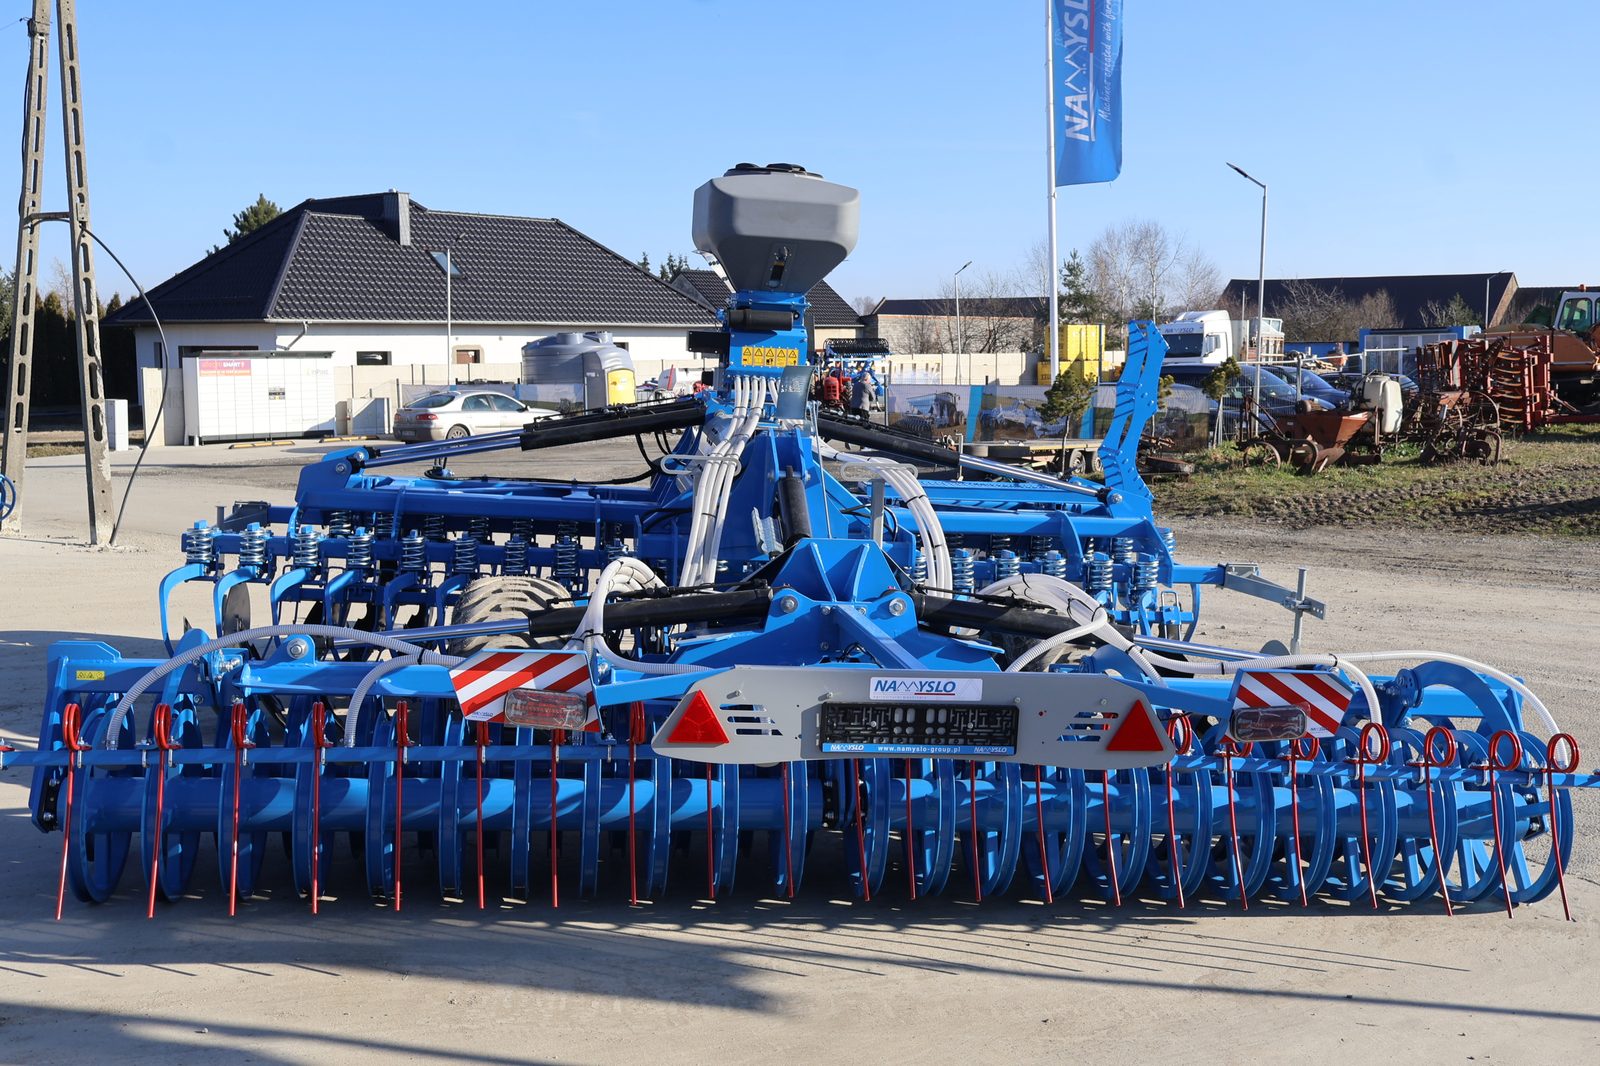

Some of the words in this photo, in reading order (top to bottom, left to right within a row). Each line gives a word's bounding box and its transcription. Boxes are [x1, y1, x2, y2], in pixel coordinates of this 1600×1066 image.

[1100, 21, 1112, 41] with
[1101, 41, 1113, 78] created
[878, 745, 961, 754] www.namyslo-group.pl
